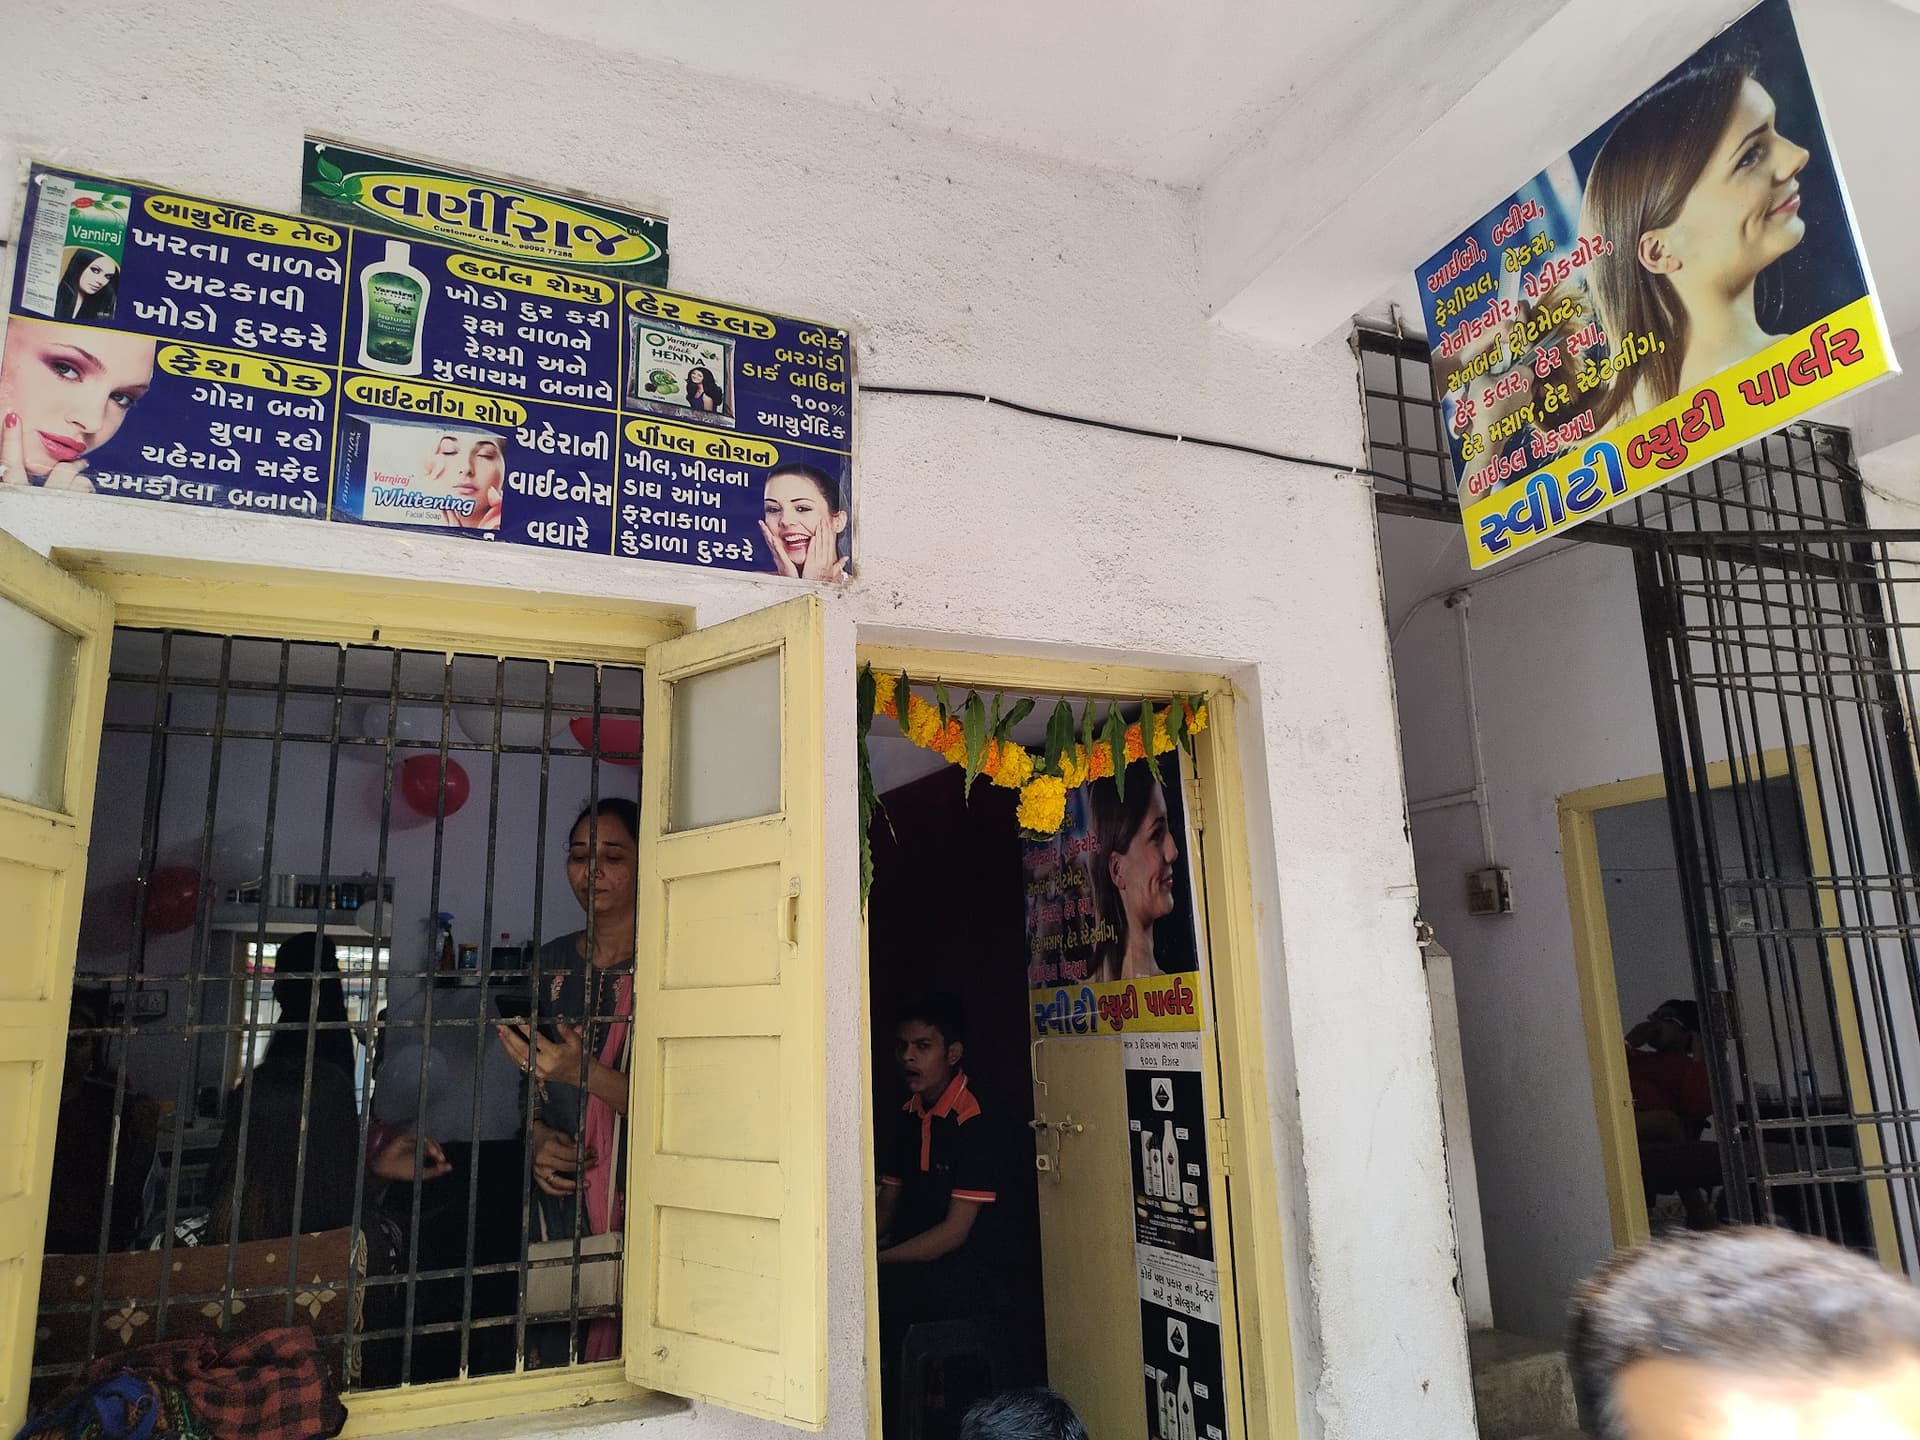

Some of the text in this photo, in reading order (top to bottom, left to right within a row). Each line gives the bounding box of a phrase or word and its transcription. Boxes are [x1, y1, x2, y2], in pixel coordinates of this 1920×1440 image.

[71, 224, 122, 246] Varniraj
[151, 199, 335, 247] આયુર્વેદિક તેલ
[434, 225, 476, 239] Customer
[479, 235, 499, 244] Care
[131, 227, 342, 285] ખરતા વાળને
[1427, 199, 1546, 293] આઈબ્રો, બ્લીચ,
[165, 270, 305, 313] અટકાવી
[458, 261, 532, 287] હર્બલ
[445, 284, 610, 329] ખોડો દુર કરી
[635, 290, 770, 338] હેર કલર
[1434, 270, 1500, 327] ફેશીયલ,
[133, 296, 328, 352] ખોડો દુરકરે
[461, 315, 592, 352] રૂક્ષ વાળને
[798, 329, 844, 351] બ્લેક
[652, 348, 706, 367] HENNA
[666, 336, 700, 350] Varniraj
[775, 350, 845, 373] બરગંડી
[1446, 297, 1583, 393] સનબર્ન ટ્રીટમેન્ટ,
[168, 348, 323, 391] ફેશ પેક
[432, 358, 613, 402] મુલાયમ બનાવે
[536, 355, 588, 377] અને
[742, 362, 846, 395] ડાર્ક બ્રાઉન
[1455, 321, 1608, 428] હેર કલર, હેર સ્પા,
[191, 383, 325, 422] ગોરા બનો
[474, 399, 518, 425] શોપ
[790, 394, 846, 417] ૧૦૦%
[209, 421, 323, 452] યુવા રહો
[515, 421, 609, 461] ચહેરાની
[756, 411, 846, 440] આયુર્વેદિક
[1479, 322, 1864, 556] સ્વીટી બ્યુટી પાર્લર
[141, 442, 321, 484] ચહેરાને સફેદ
[705, 438, 772, 466] લોશન
[1461, 430, 1485, 462] હેર
[1467, 409, 1596, 498] બ્રાઈડલ મેકઅપ
[96, 471, 318, 514] ચમકીલા બનાવો
[373, 471, 412, 487] Varniraj
[508, 468, 613, 506] વાઈટનેસ
[622, 478, 722, 509] ડાઘ આંખ
[371, 485, 476, 517] Whitening
[405, 511, 442, 521] Facial Soap
[622, 504, 727, 534] ફરતાકાળા
[526, 516, 590, 549] વધારે
[620, 524, 754, 564] કુંડાળા દુરકરે
[1034, 976, 1194, 1036] સ્વીટી બ્યુટી પાર્લર
